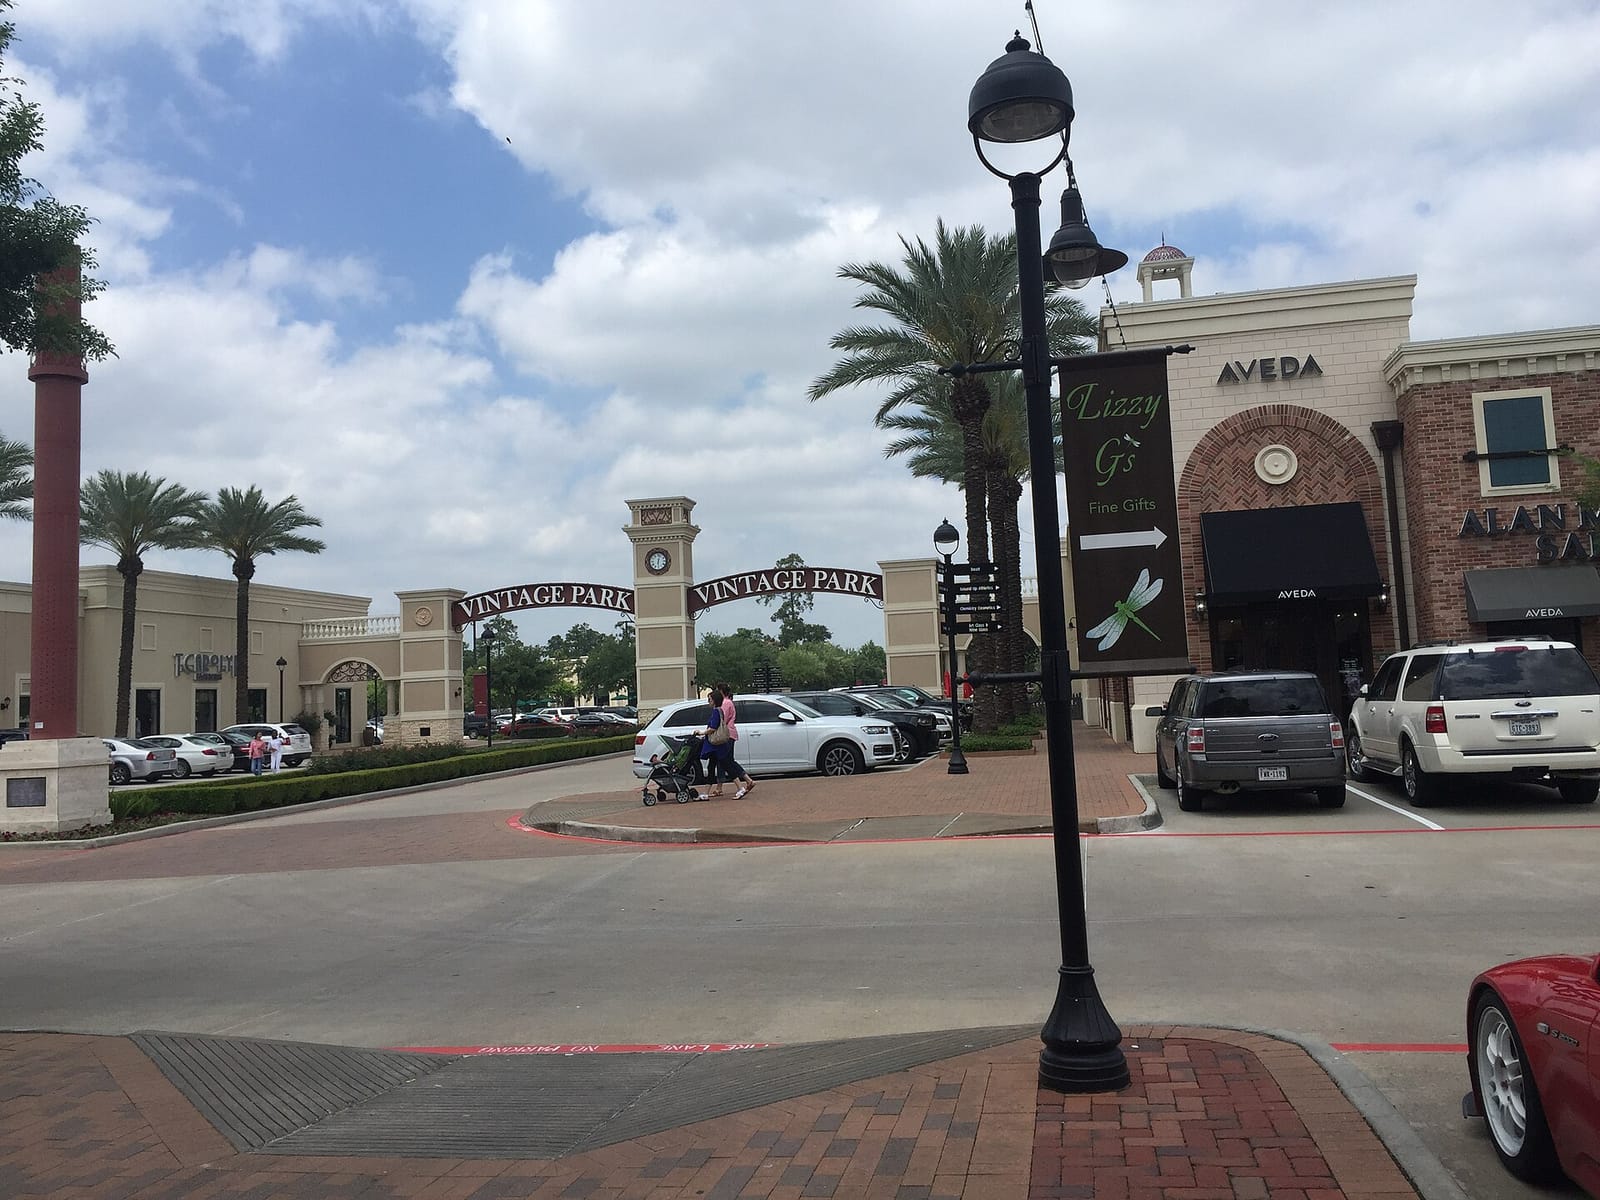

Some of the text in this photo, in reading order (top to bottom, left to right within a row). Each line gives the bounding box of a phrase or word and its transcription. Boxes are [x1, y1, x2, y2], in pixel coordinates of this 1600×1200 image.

[1216, 353, 1323, 385] AVEDA
[1066, 382, 1162, 429] Lizzy
[1089, 498, 1156, 514] Fine Gifts
[1457, 503, 1567, 536] ALAN
[458, 585, 632, 618] VINTAGE PARK
[693, 570, 877, 604] VINTAGE PARK
[1278, 589, 1316, 599] AVEDA
[1525, 608, 1564, 618] AVEDA
